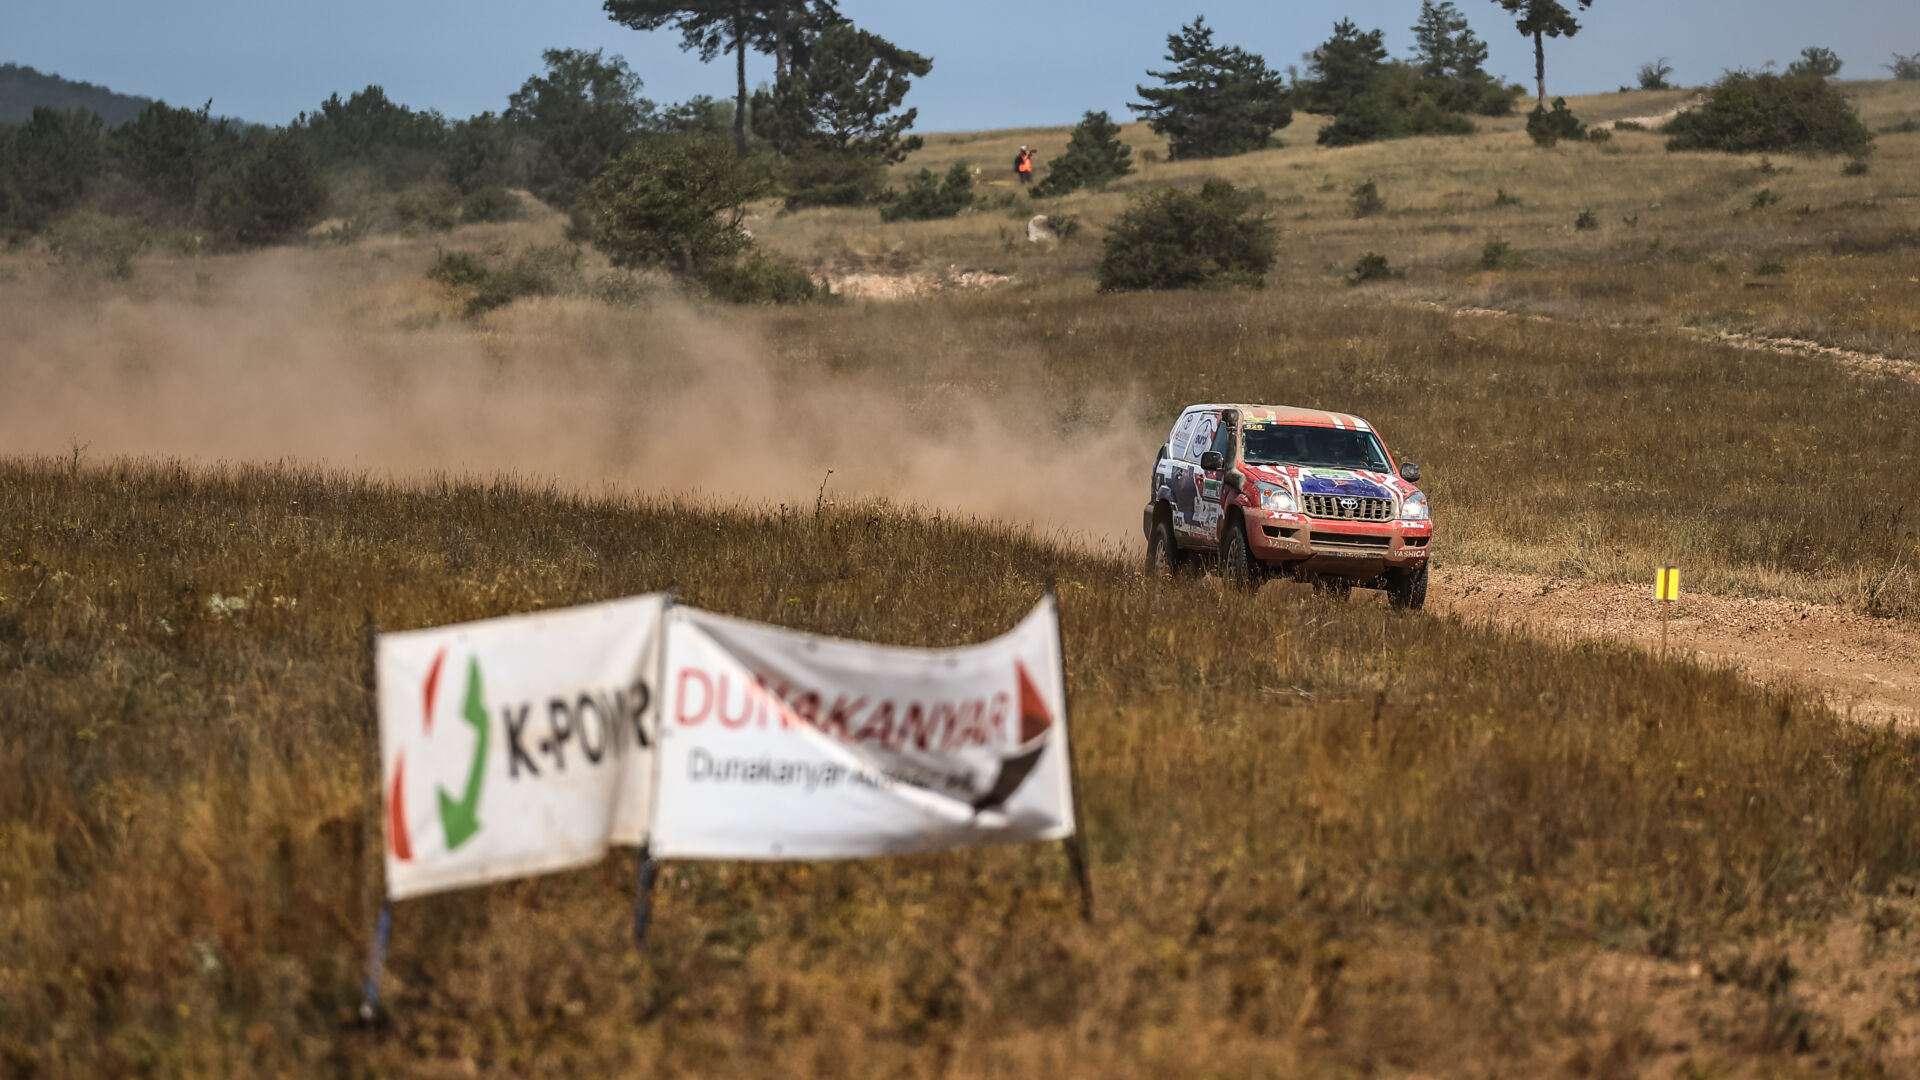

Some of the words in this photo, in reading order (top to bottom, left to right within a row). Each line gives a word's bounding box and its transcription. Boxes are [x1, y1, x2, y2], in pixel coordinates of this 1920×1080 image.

[1394, 550, 1426, 558] YASHICA
[674, 667, 1010, 753] DUNAKANYAR
[688, 748, 845, 793] Dunakanyar
